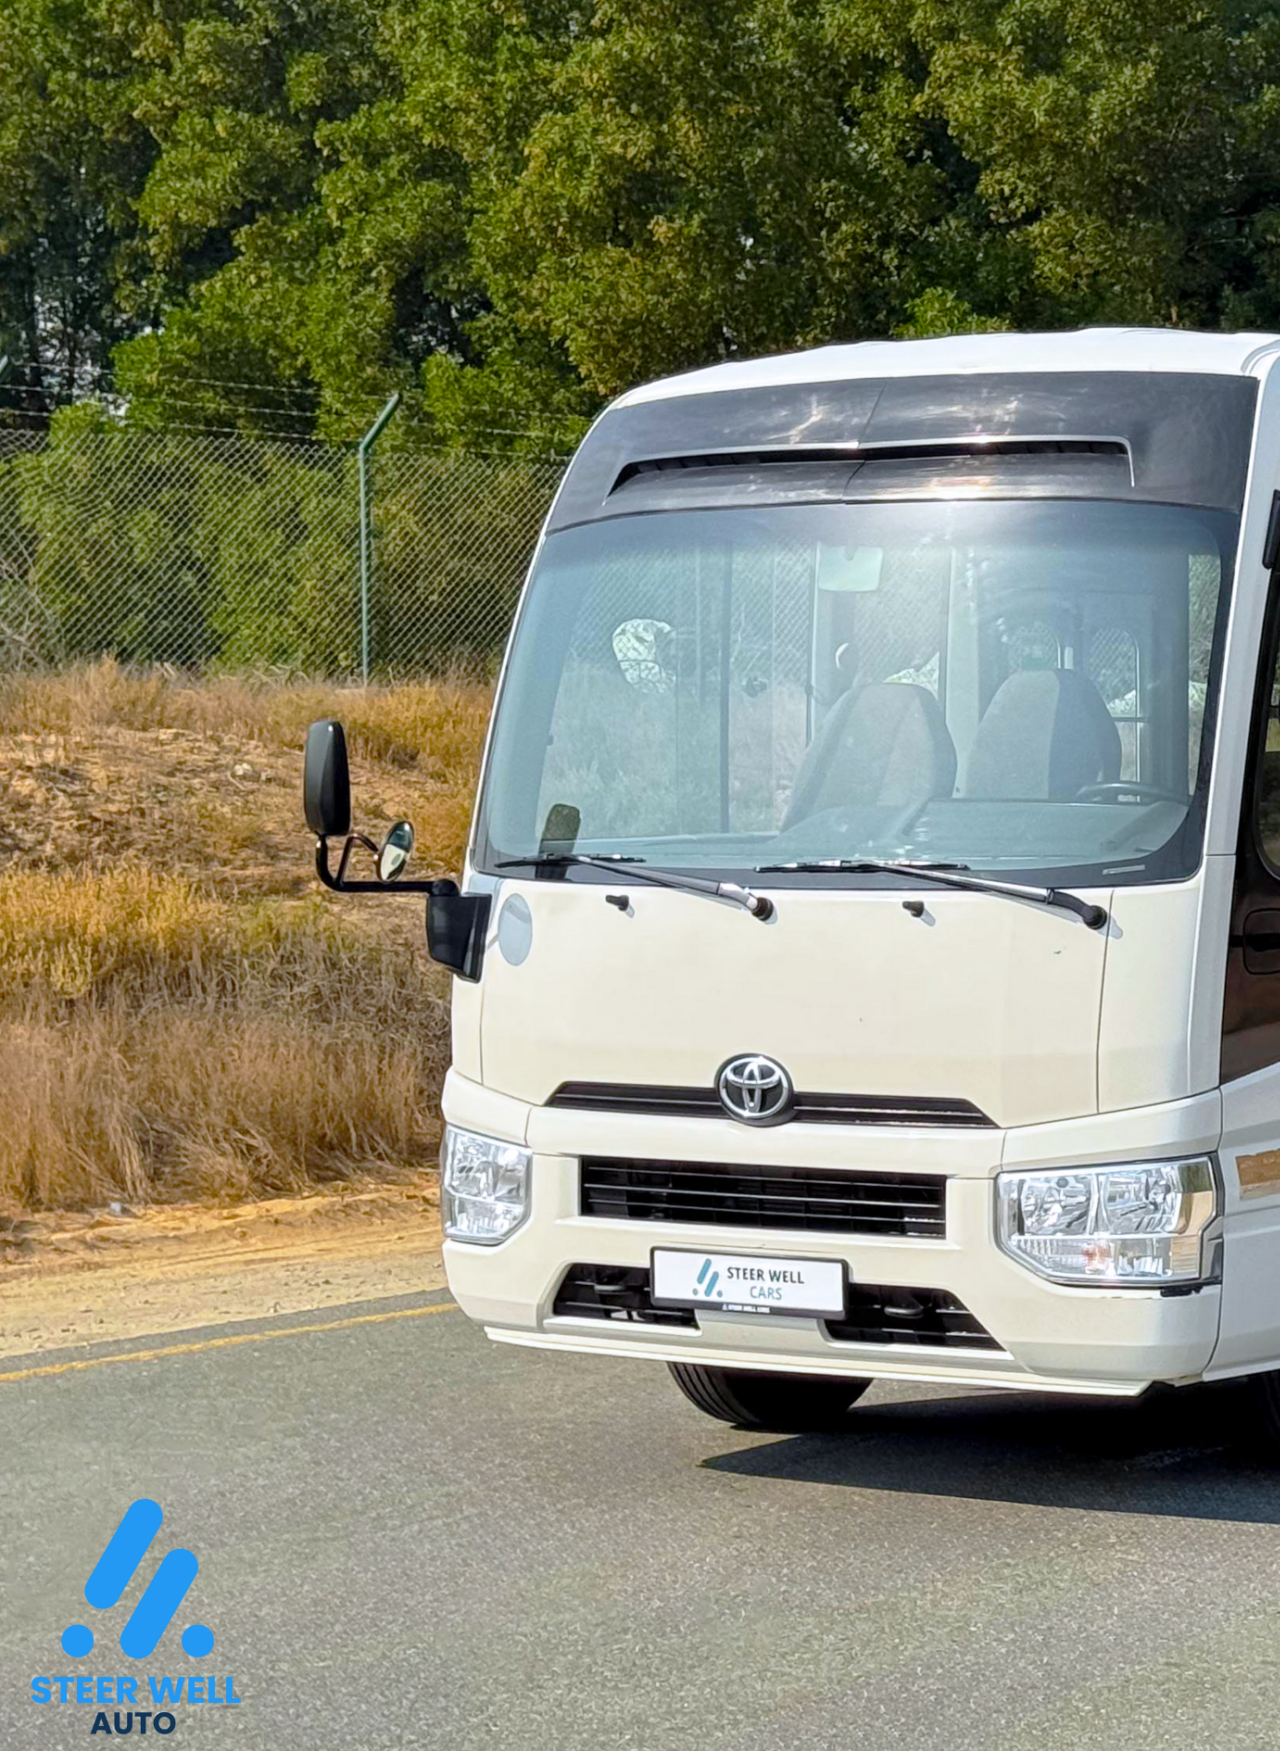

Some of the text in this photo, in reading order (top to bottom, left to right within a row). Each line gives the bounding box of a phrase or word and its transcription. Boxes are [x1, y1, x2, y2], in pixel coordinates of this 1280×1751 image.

[728, 1267, 804, 1284] STEER WELL
[750, 1287, 782, 1300] CARS
